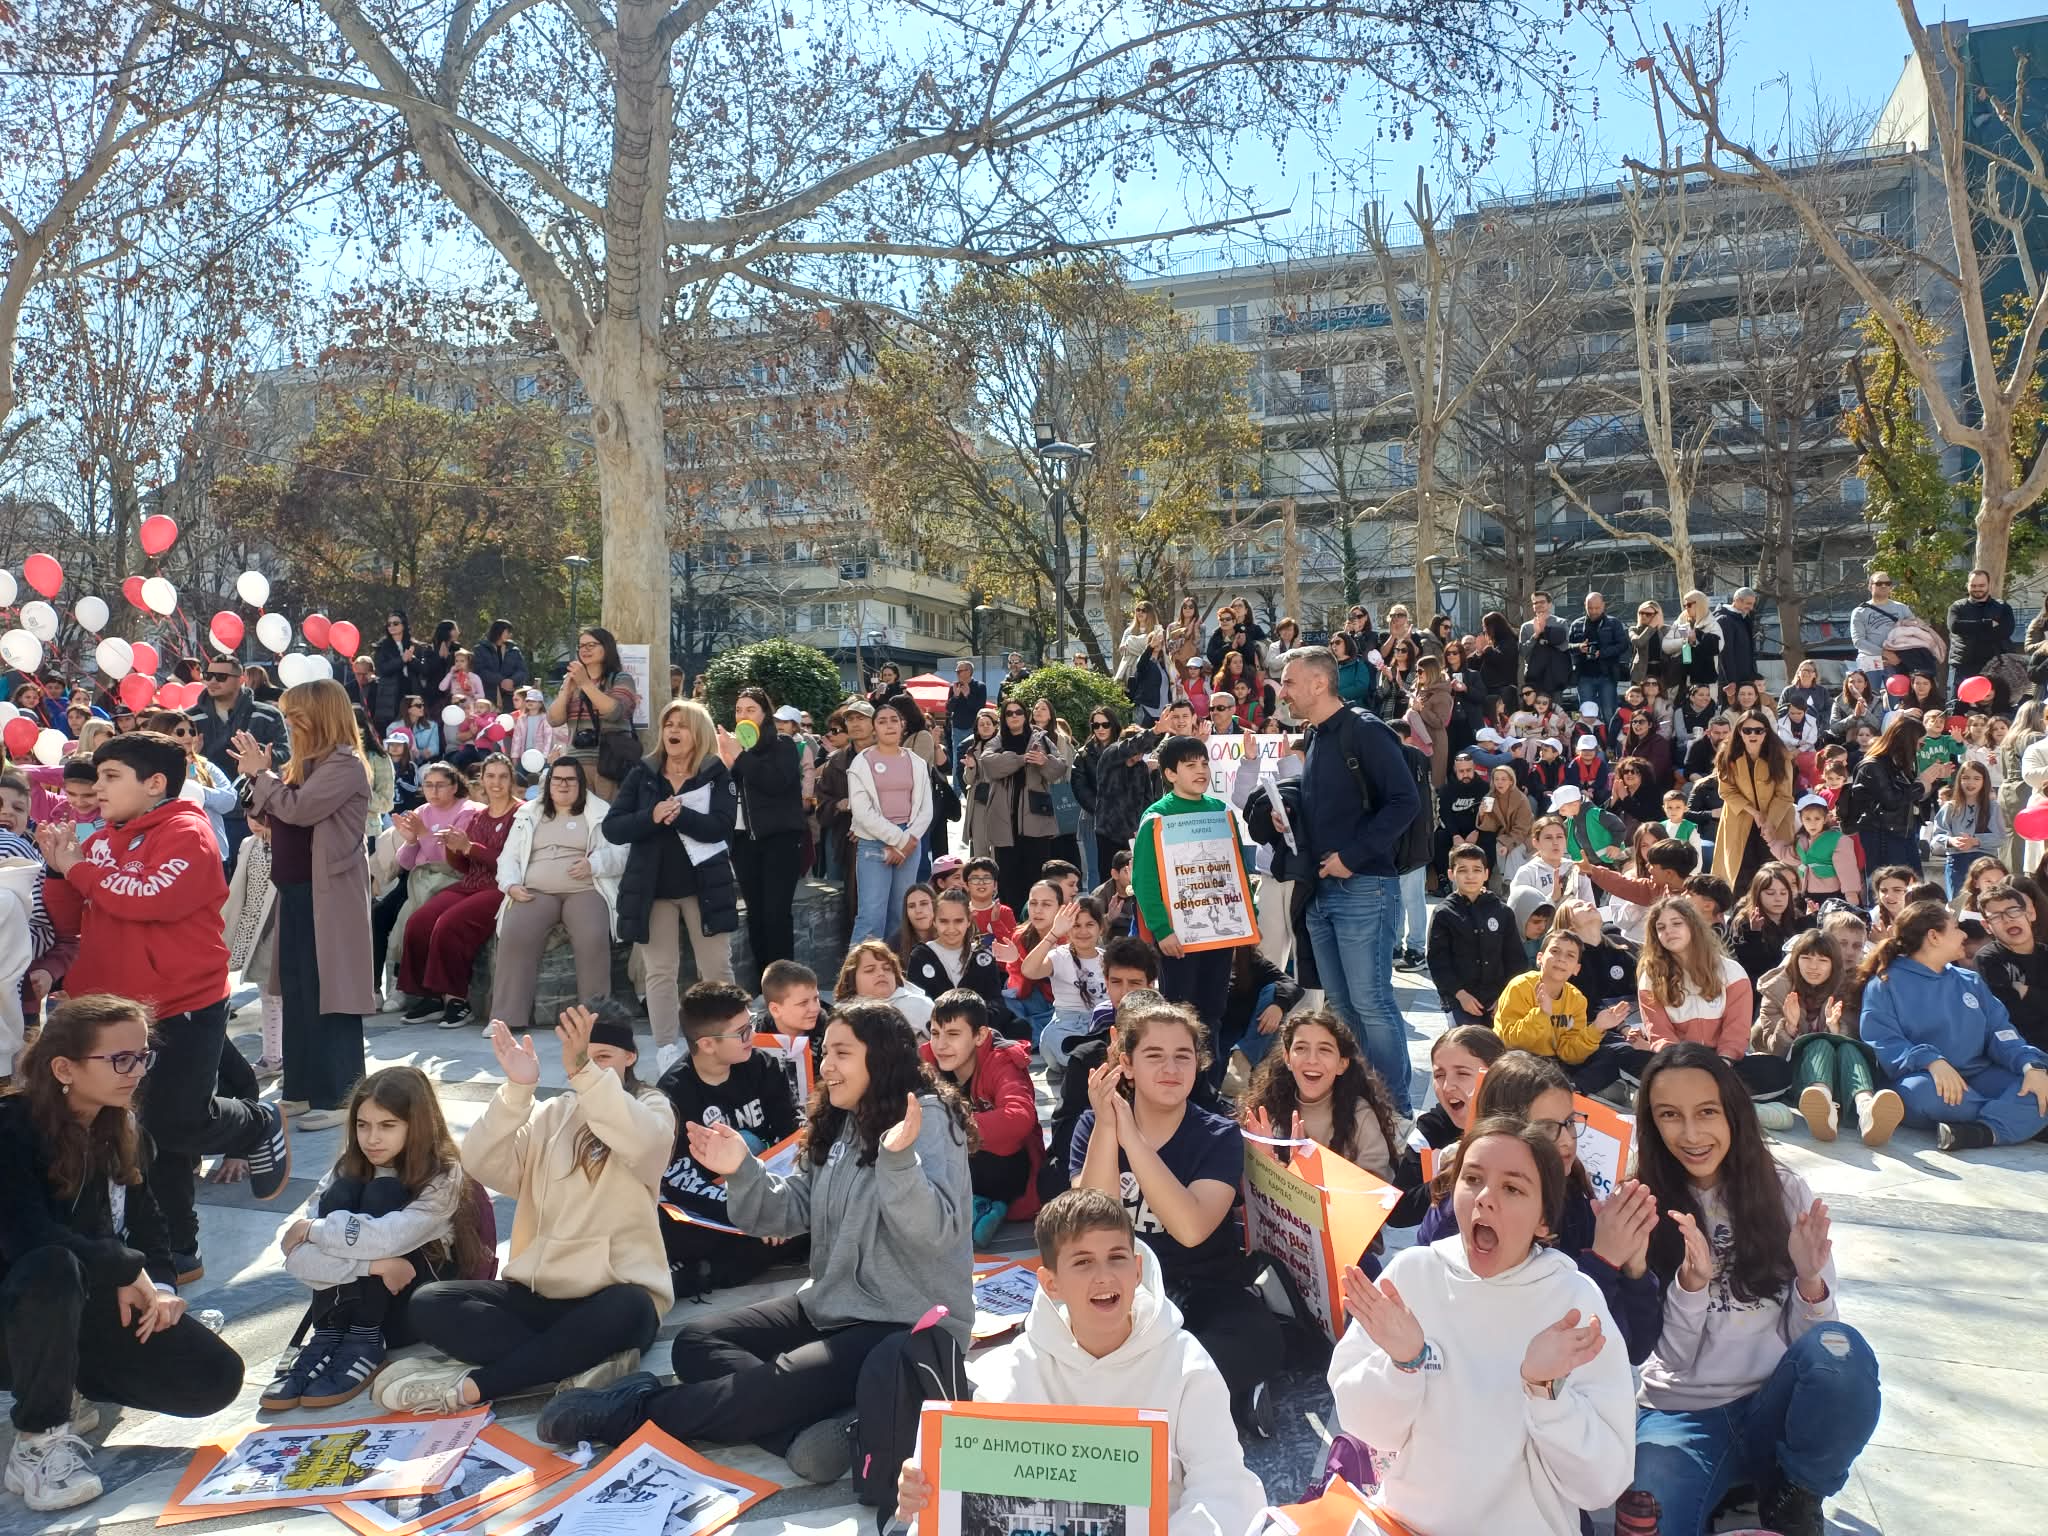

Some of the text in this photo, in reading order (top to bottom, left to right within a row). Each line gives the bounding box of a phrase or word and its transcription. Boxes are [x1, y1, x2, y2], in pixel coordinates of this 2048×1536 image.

[1175, 861, 1231, 876] Γίνε η φωνή
[1190, 882, 1210, 891] που
[1174, 896, 1210, 911] σβήσει
[983, 1438, 1067, 1457] ΔΗΜΟΤΙΚΟ
[1071, 1445, 1139, 1463] ΣΧΟΛΕΙΟ
[1013, 1464, 1077, 1482] ΛΑΡΙΣΑΣ
